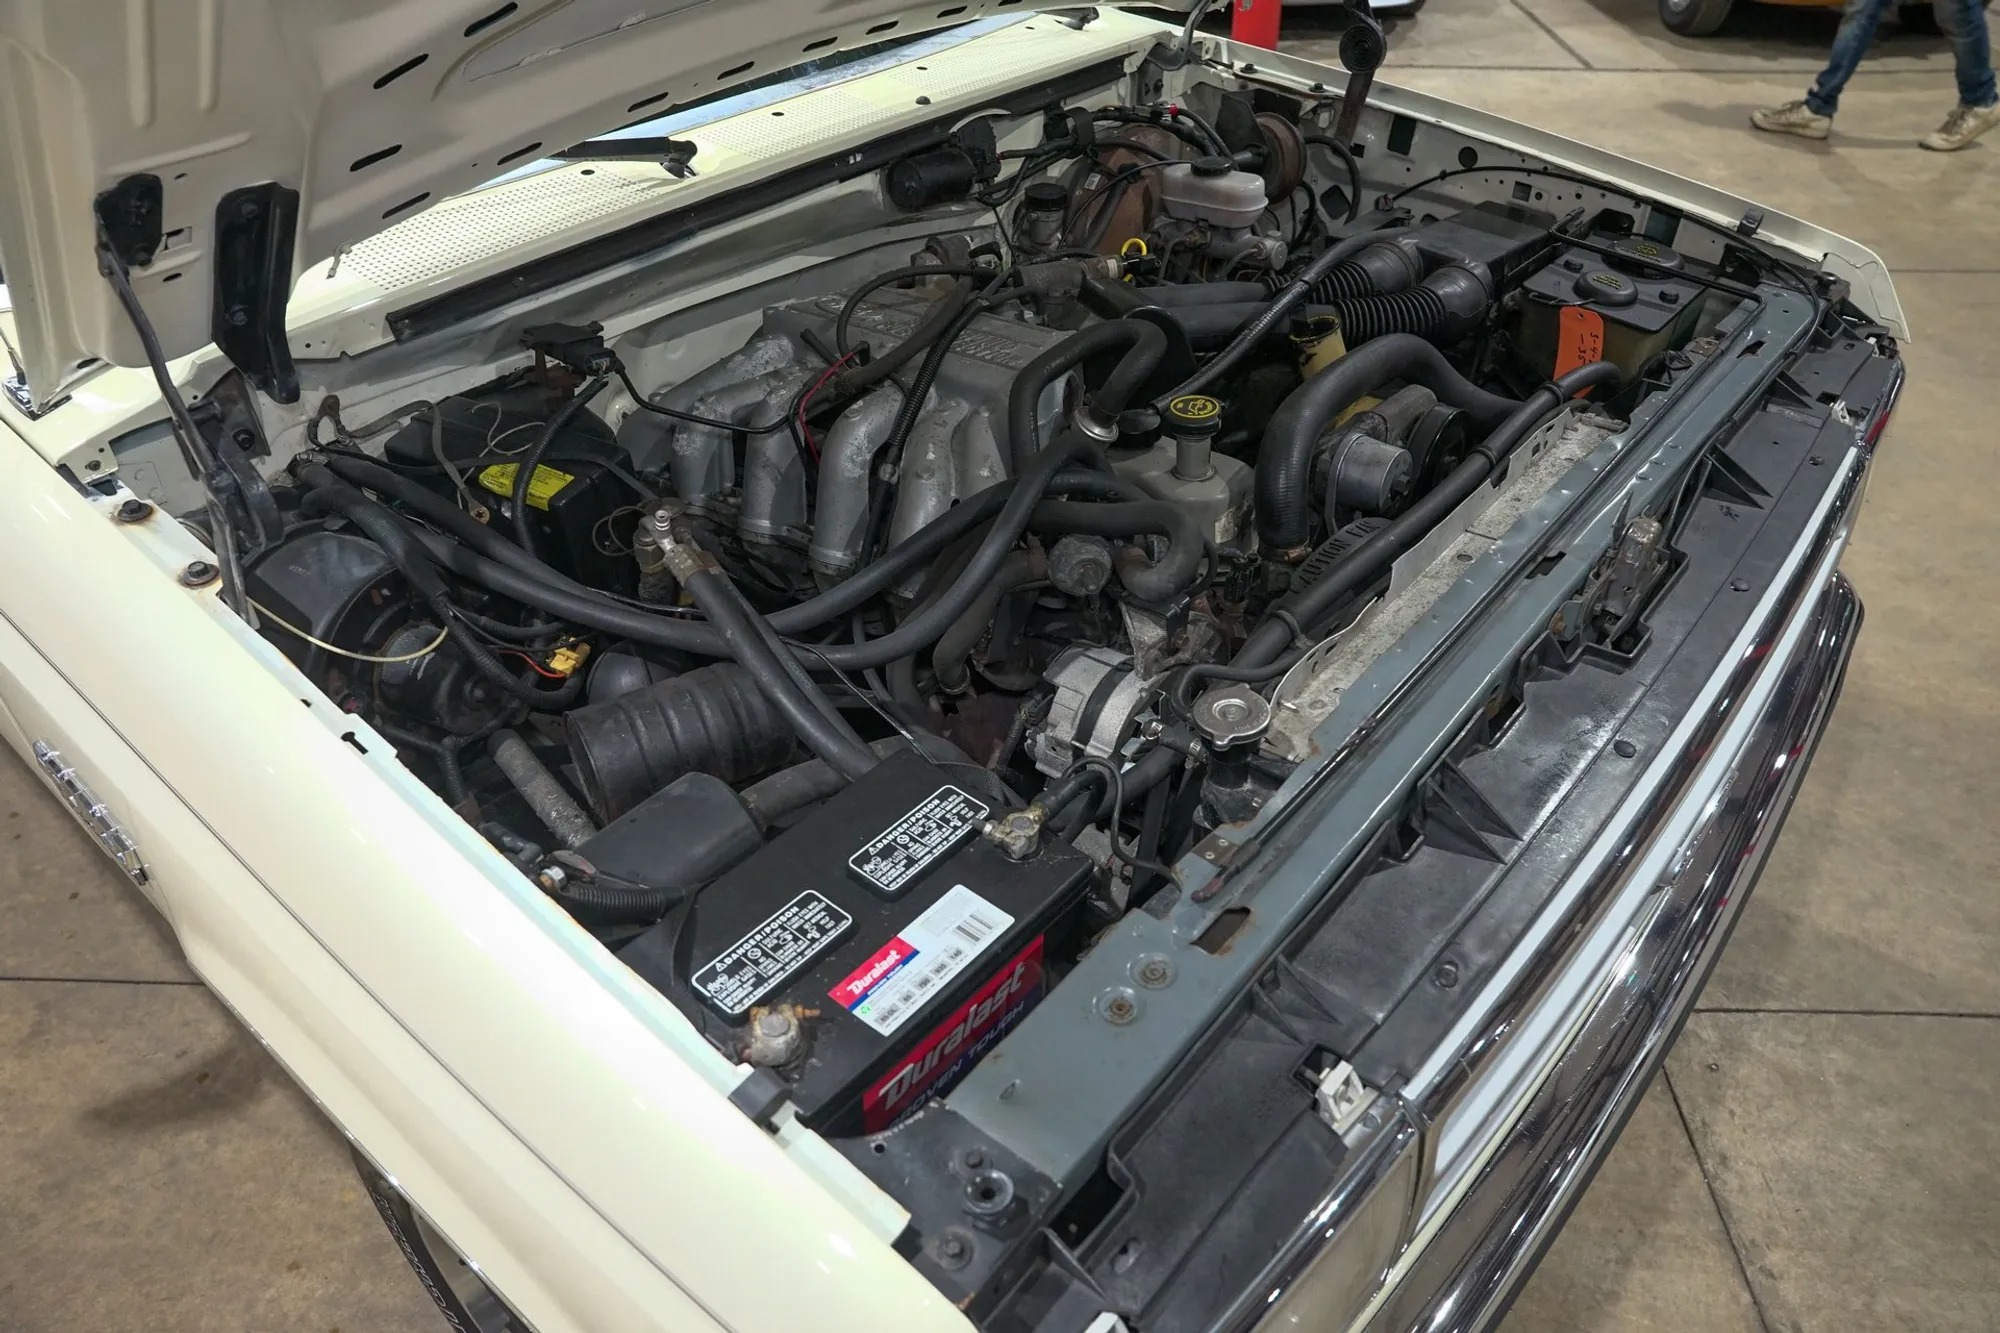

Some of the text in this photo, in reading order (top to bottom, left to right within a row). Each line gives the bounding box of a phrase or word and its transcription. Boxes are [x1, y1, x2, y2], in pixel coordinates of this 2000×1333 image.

[875, 798, 941, 848] DANGER/POISON
[722, 905, 800, 964] DANGER/POISON
[845, 948, 902, 996] Duralast
[879, 962, 1024, 1110] Duralast
[968, 1001, 1024, 1058] TOUGH
